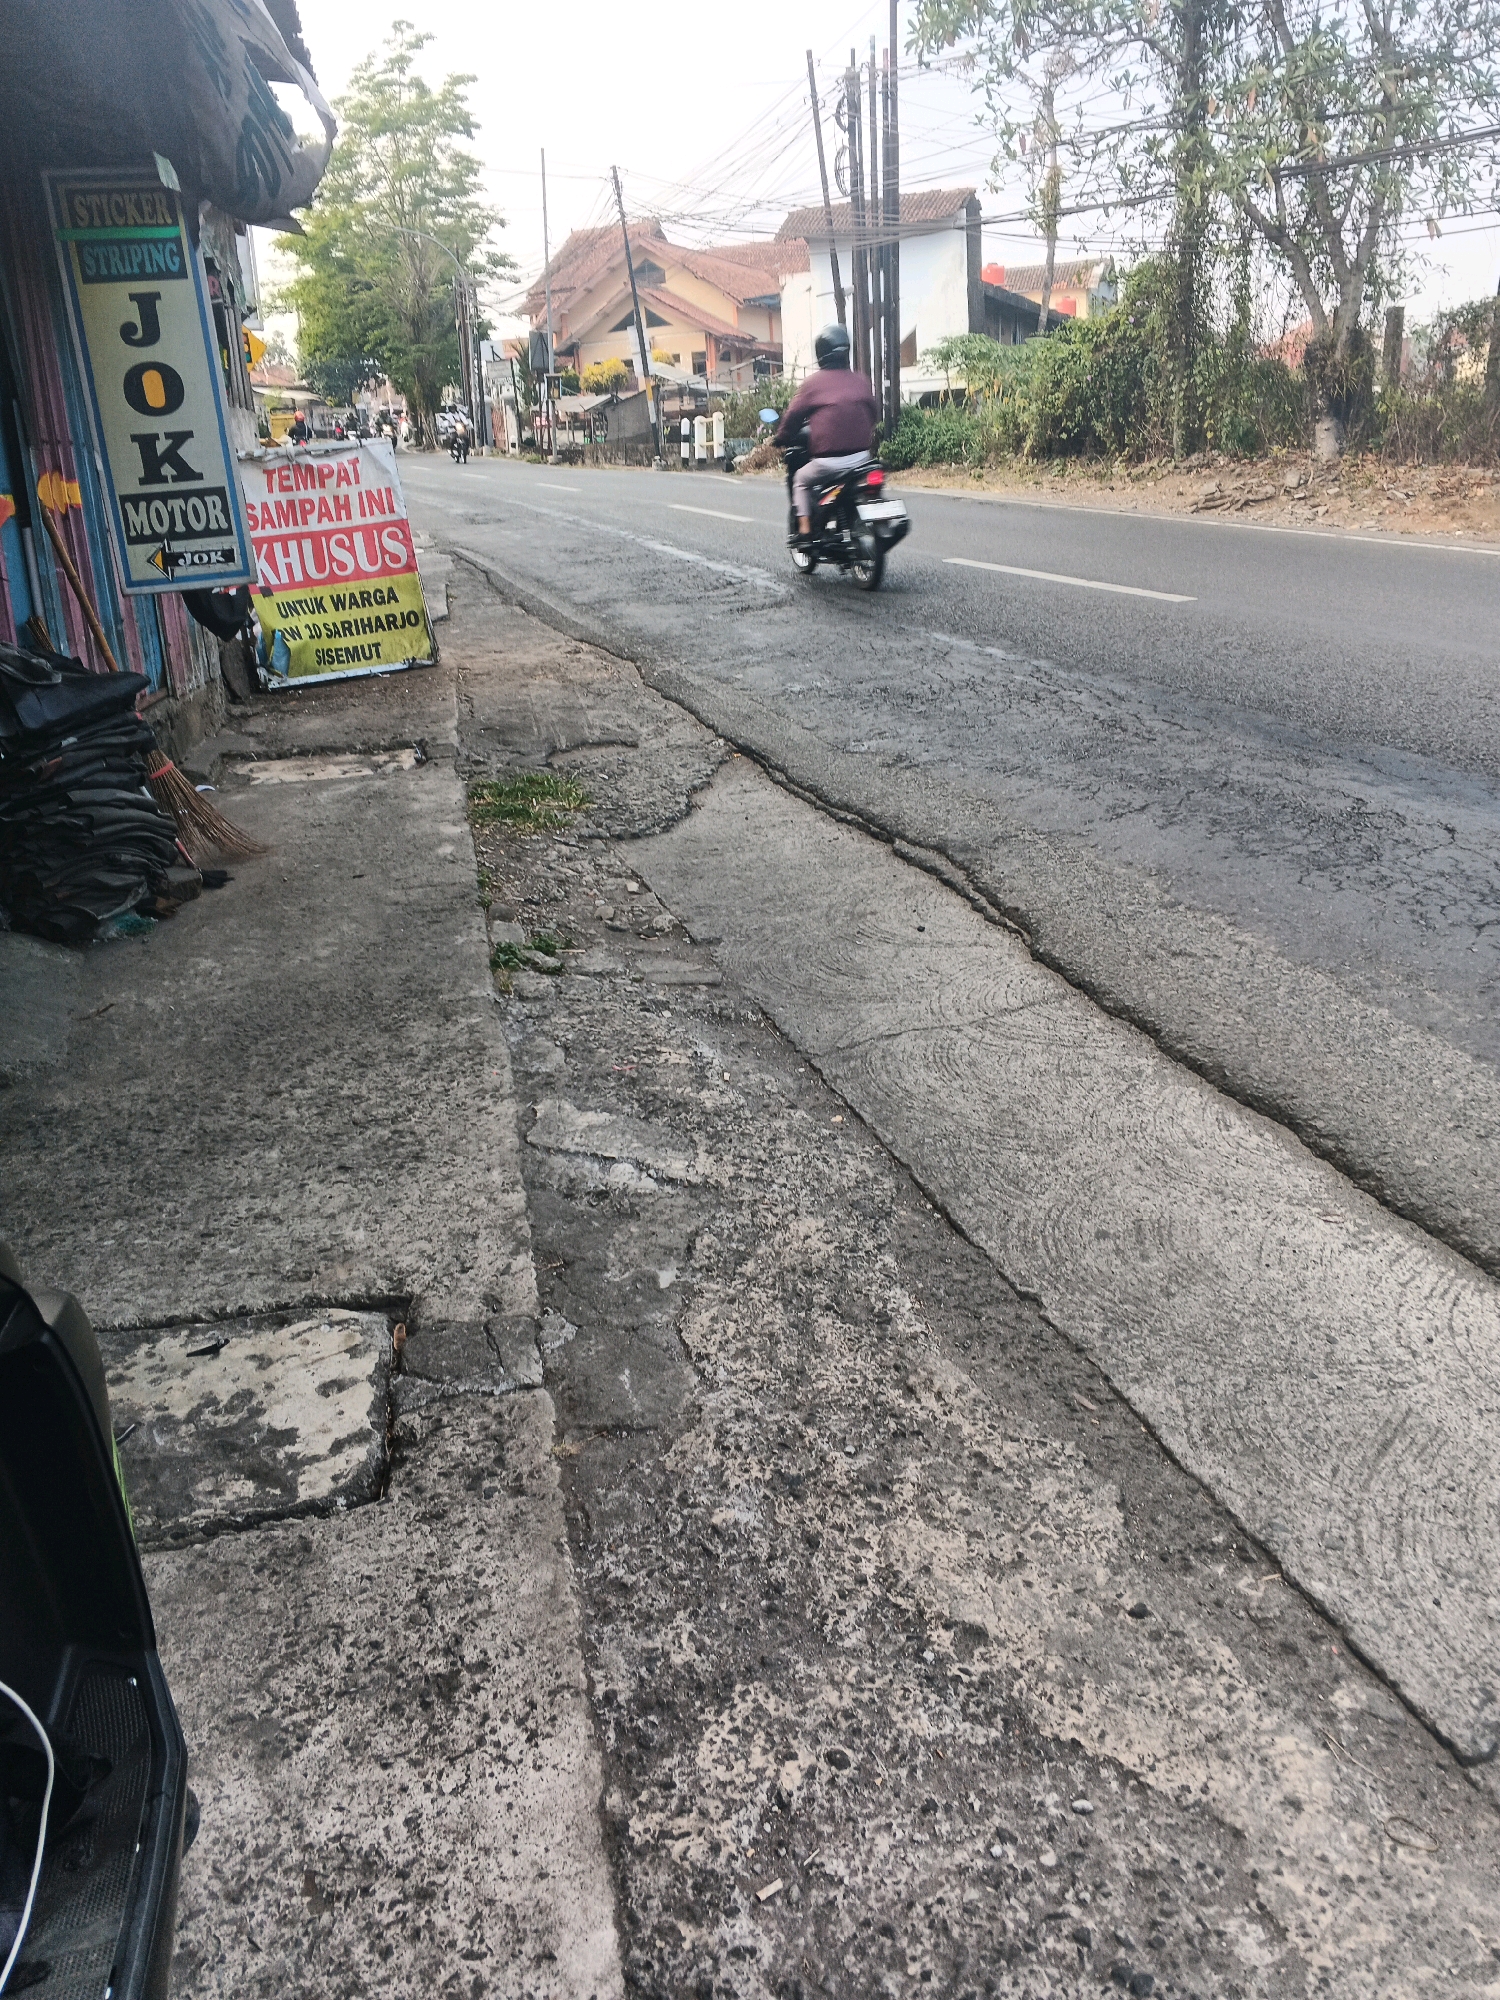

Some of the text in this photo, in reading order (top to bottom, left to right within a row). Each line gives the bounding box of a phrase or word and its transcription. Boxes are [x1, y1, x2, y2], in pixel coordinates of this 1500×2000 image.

[73, 192, 173, 228] STICKER
[82, 241, 180, 276] STRIPING
[119, 291, 204, 486] JOK
[263, 457, 361, 494] TEMPAT
[124, 495, 228, 537] MOTOR
[246, 487, 396, 532] SAMPAH INI
[177, 551, 225, 566] JOK
[252, 527, 408, 587] KHUSUS
[276, 586, 399, 619] UNTUK WARGA
[304, 623, 323, 640] 10
[322, 610, 420, 639] SARIHARJO
[315, 642, 381, 667] SISEMUT
